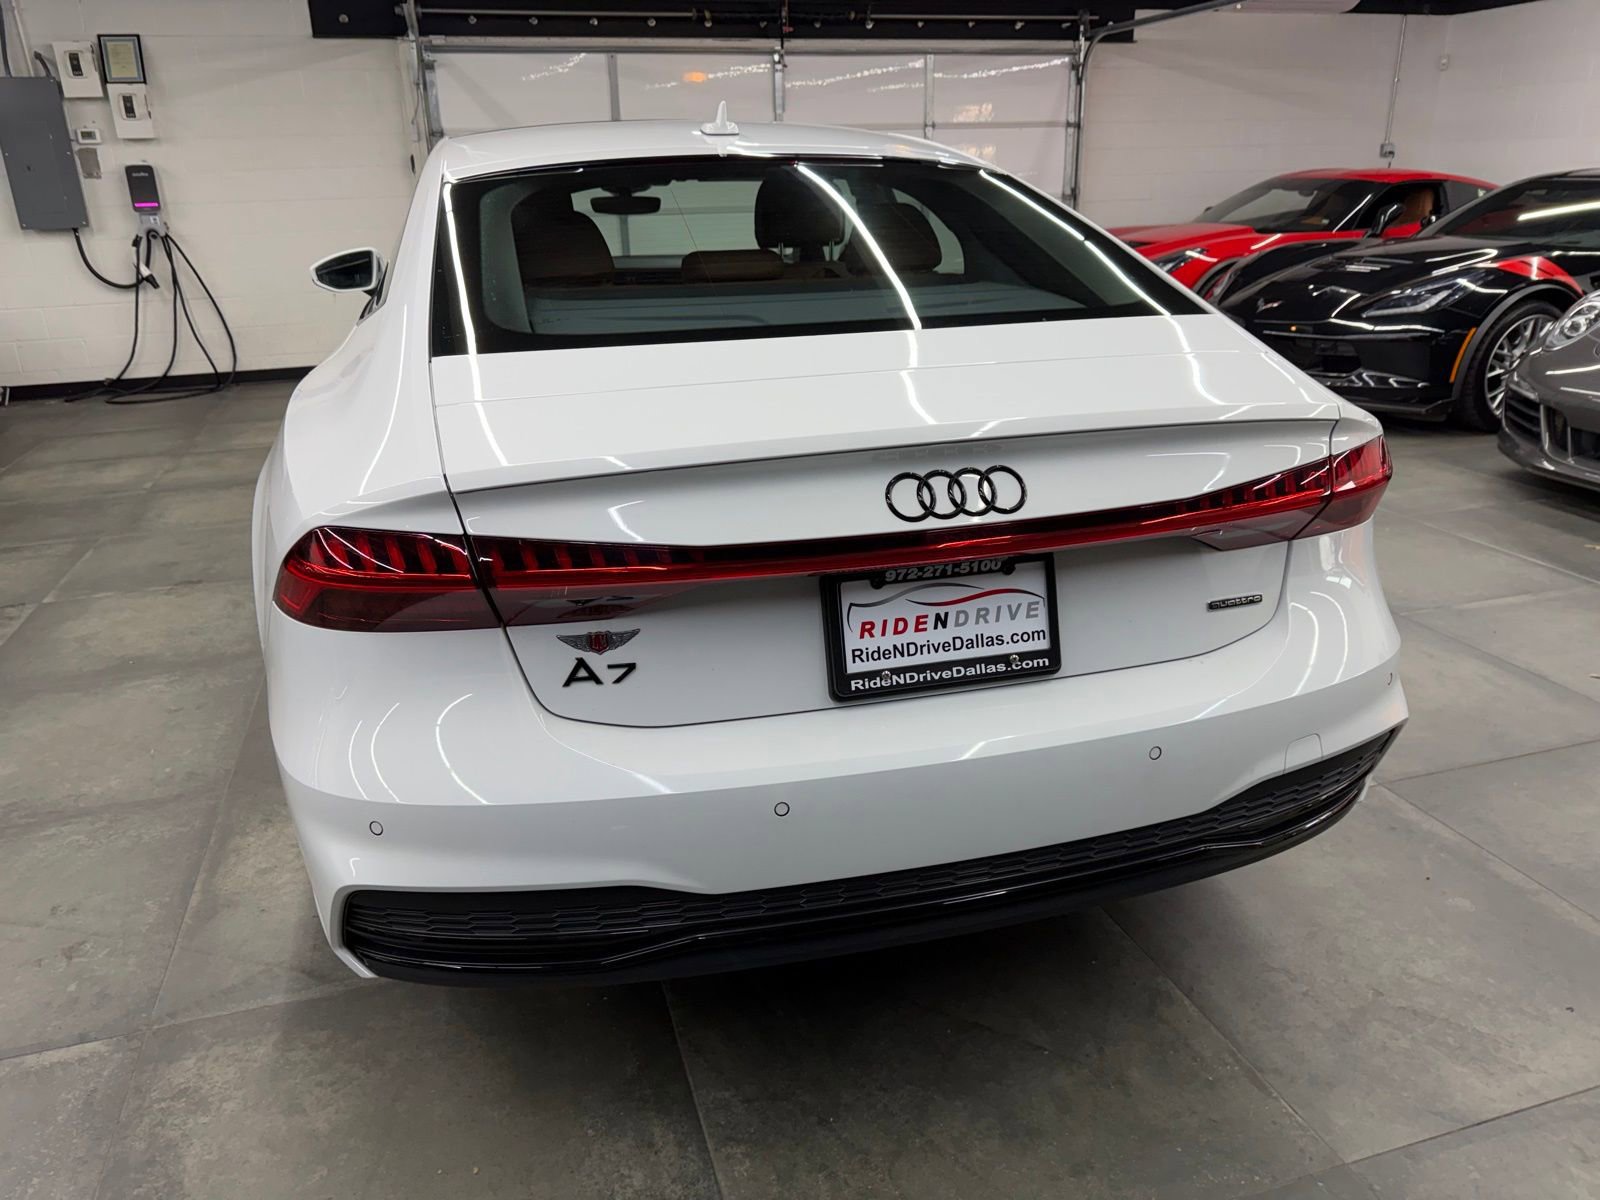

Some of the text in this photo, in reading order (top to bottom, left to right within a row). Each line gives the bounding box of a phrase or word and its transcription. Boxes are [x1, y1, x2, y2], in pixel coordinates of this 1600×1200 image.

[859, 601, 1040, 640] RIDENDRIVE
[852, 629, 1046, 664] RideNDriveDallas.com
[562, 657, 636, 687] A7
[850, 657, 1049, 691] RideNDriveDallas.com
